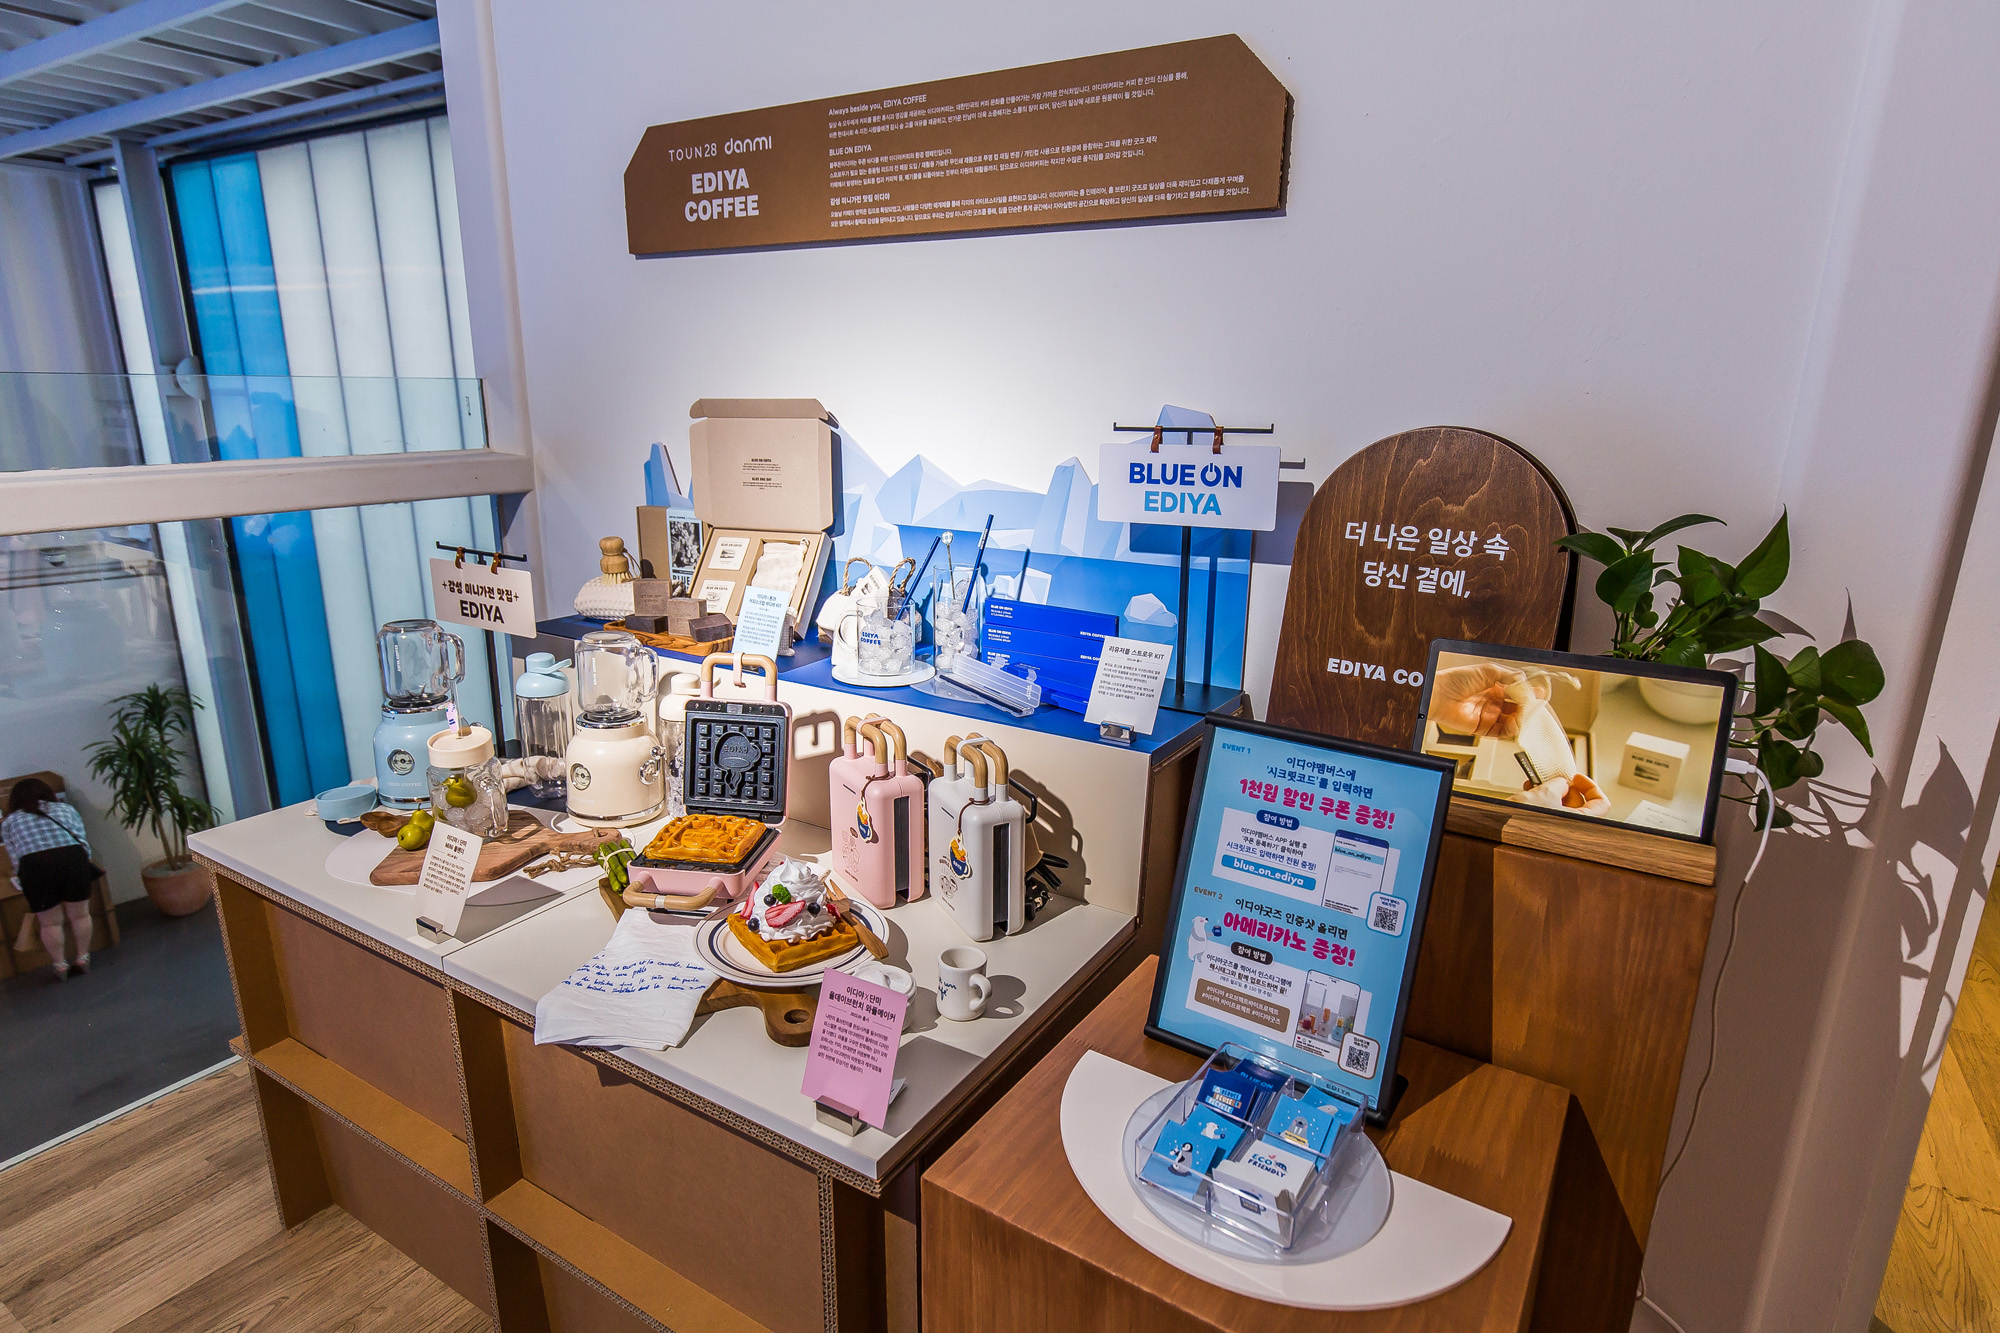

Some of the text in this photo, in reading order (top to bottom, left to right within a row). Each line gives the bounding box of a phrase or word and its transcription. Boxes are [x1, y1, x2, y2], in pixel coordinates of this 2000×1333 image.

[828, 94, 927, 116] Always beside you, EDIYA COFFEE
[668, 135, 773, 162] TOUN28 danmi
[829, 144, 872, 157] BLUE ON EDIYA
[691, 167, 750, 195] EDIYA
[684, 194, 760, 223] COFFEE
[830, 192, 890, 206] 감성 미니가전 맛집 이디야
[1129, 462, 1243, 488] BLUE ON
[1144, 490, 1222, 516] EDIYA
[1345, 521, 1510, 561] 더 나은 일상 속
[1363, 561, 1471, 599] 당신 곁에,
[448, 580, 513, 603] 감성 미니가전 맛집
[459, 599, 505, 624] EDIYA
[860, 637, 881, 646] COFFEE
[862, 631, 879, 639] EDIYA
[1108, 645, 1130, 656] 리유저블
[1130, 648, 1153, 659] 스트로우
[1154, 652, 1165, 661] KIT
[1327, 657, 1387, 682] EDIYA
[1222, 743, 1245, 752] EVENT
[1287, 757, 1356, 781] 이디야멤버스에
[1332, 781, 1373, 799] 입력하면
[1240, 779, 1395, 829] 1천원 할인 쿠폰 증정!
[1264, 813, 1293, 827] 참여 방법
[1241, 827, 1273, 841] 이디야멤버스
[1289, 840, 1300, 848] 실행
[1227, 841, 1316, 871] 시크릿코드 입력하면 전원 증정!
[1281, 846, 1303, 857] 클릭하여
[1335, 847, 1371, 860] blue_on_ediya
[1233, 858, 1305, 887] blue_on_ediya
[1194, 886, 1217, 897] EVENT
[1235, 899, 1348, 940] 이디야굿즈 인증샷 올리면
[1223, 912, 1356, 967] 아메리카노 증정!
[1238, 946, 1266, 962] 참여 방법
[1207, 954, 1292, 987] 이디야굿즈를 찍어서 인스타그램에
[1209, 963, 1287, 995] 해시태그와 함께 업로드하면 끝!
[1207, 986, 1224, 996] #이디야
[828, 990, 864, 1011] 올데이브런치
[865, 1005, 897, 1023] 와플메이커
[1252, 1010, 1280, 1025] #이디야굿즈
[1221, 1088, 1240, 1100] REDUCE
[1260, 1081, 1274, 1089] ON
[1325, 1083, 1351, 1097] EDIYA
[1207, 1097, 1233, 1113] RECYCLE
[1214, 1093, 1233, 1106] REUSE
[1247, 1158, 1286, 1178] FRIENDLY
[1252, 1153, 1273, 1166] ECO
